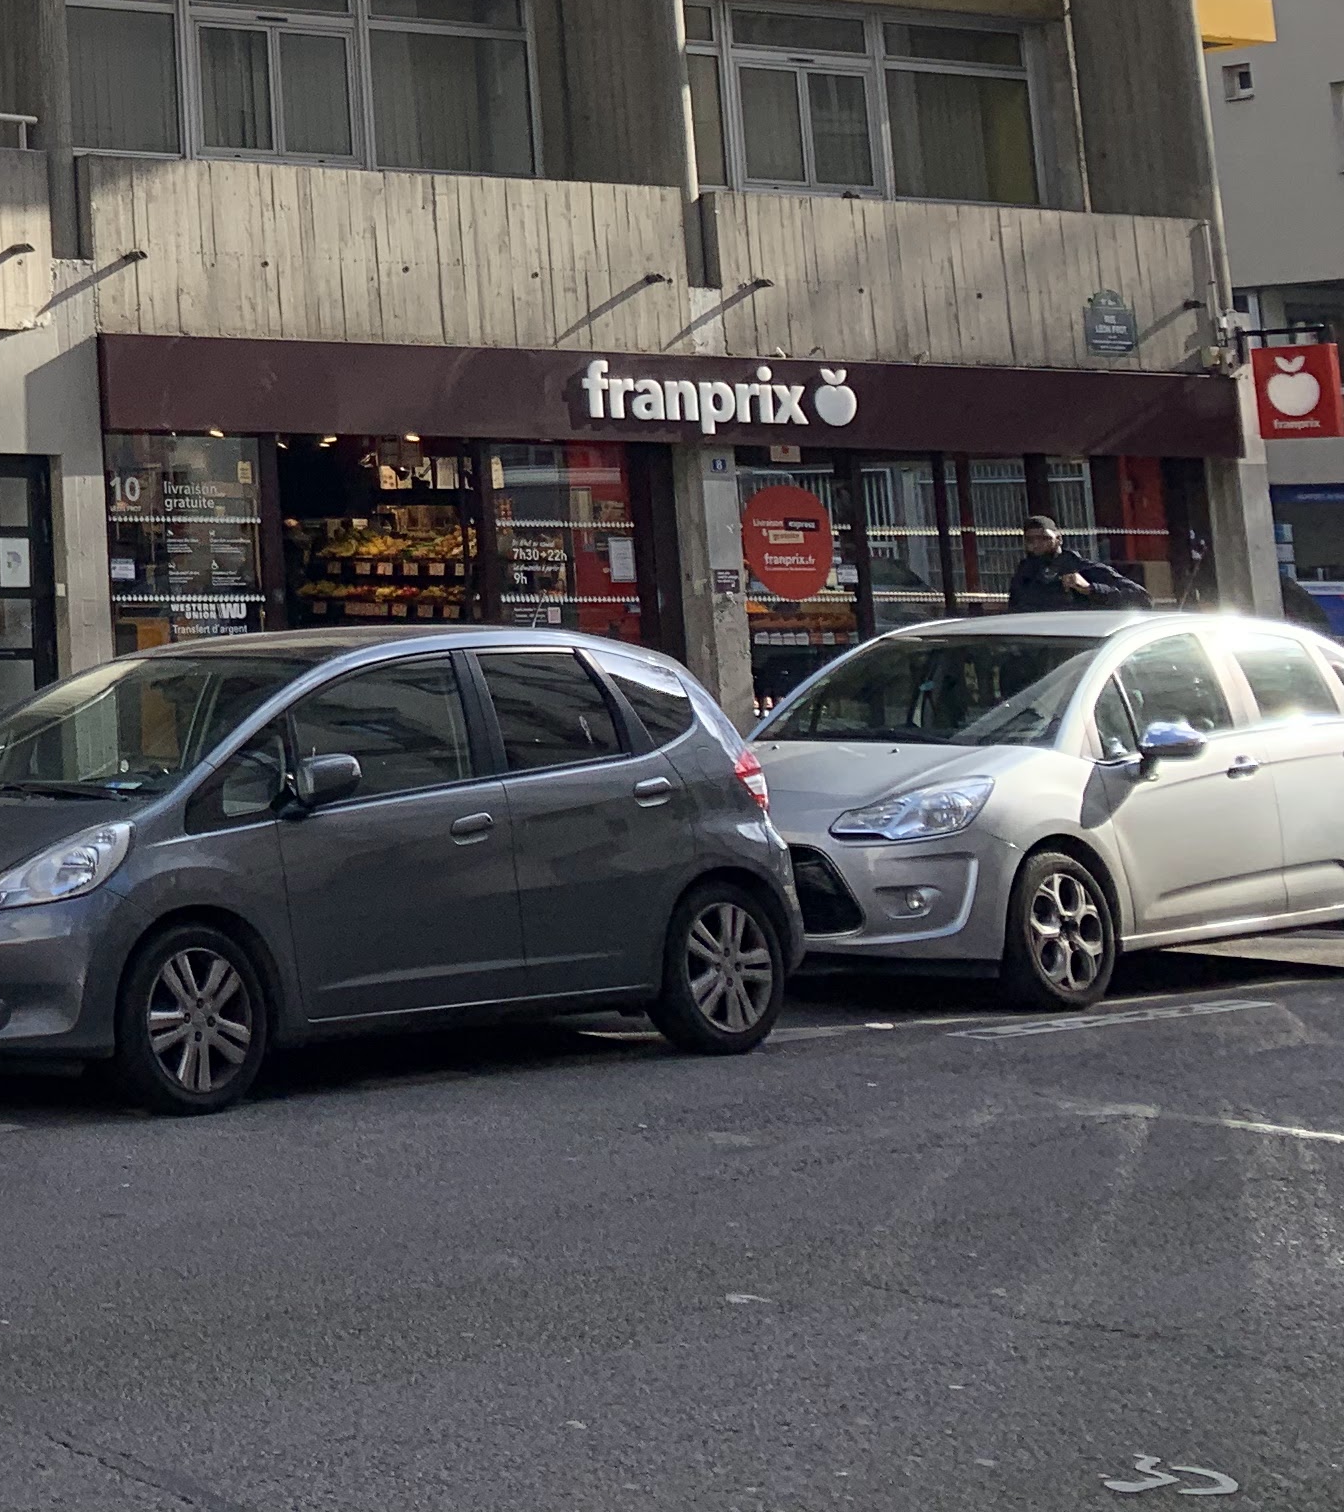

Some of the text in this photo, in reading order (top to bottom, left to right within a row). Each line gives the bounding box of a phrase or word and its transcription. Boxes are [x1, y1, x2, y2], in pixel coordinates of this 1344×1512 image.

[581, 359, 810, 435] franprix
[1273, 418, 1321, 430] franprix
[715, 459, 723, 470] 8
[109, 476, 141, 502] 10
[163, 480, 217, 495] livraison
[164, 496, 215, 512] gratuite
[752, 518, 816, 530] Livraison express
[512, 548, 568, 562] 7h30 22h
[763, 552, 816, 567] franprix.fr
[513, 571, 528, 585] 9h
[170, 603, 217, 612] WESTERN
[185, 611, 218, 620] UNION
[172, 624, 248, 636] Transfert d'argent
